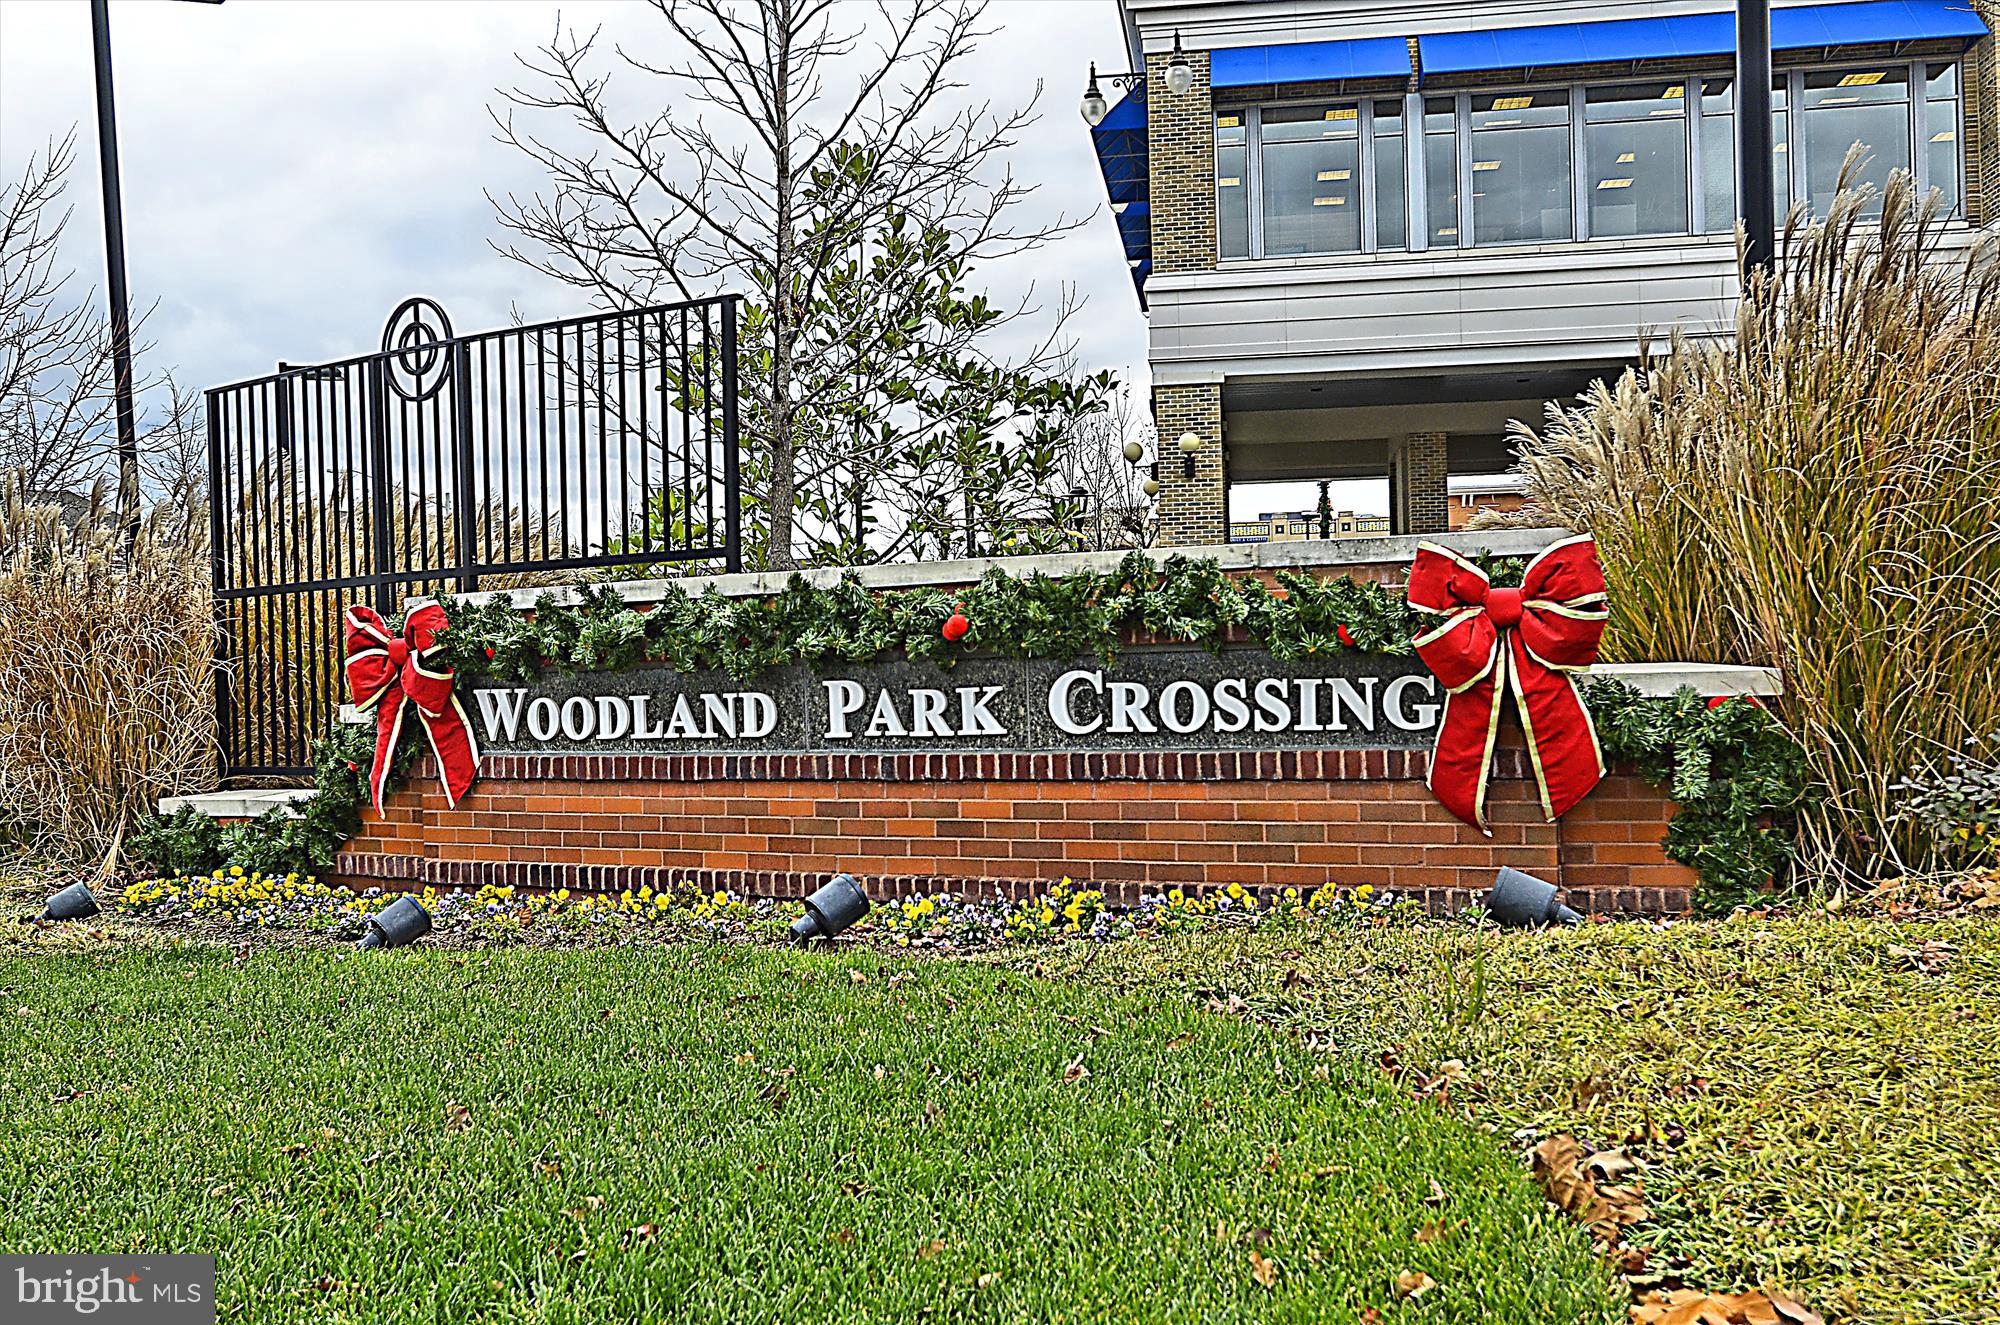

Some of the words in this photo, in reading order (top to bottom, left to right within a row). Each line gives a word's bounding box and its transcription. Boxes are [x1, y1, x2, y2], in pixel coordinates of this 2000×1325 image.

[473, 688, 778, 742] WOODLAND
[822, 680, 1008, 739] PARK
[1048, 669, 1442, 734] CROSSING
